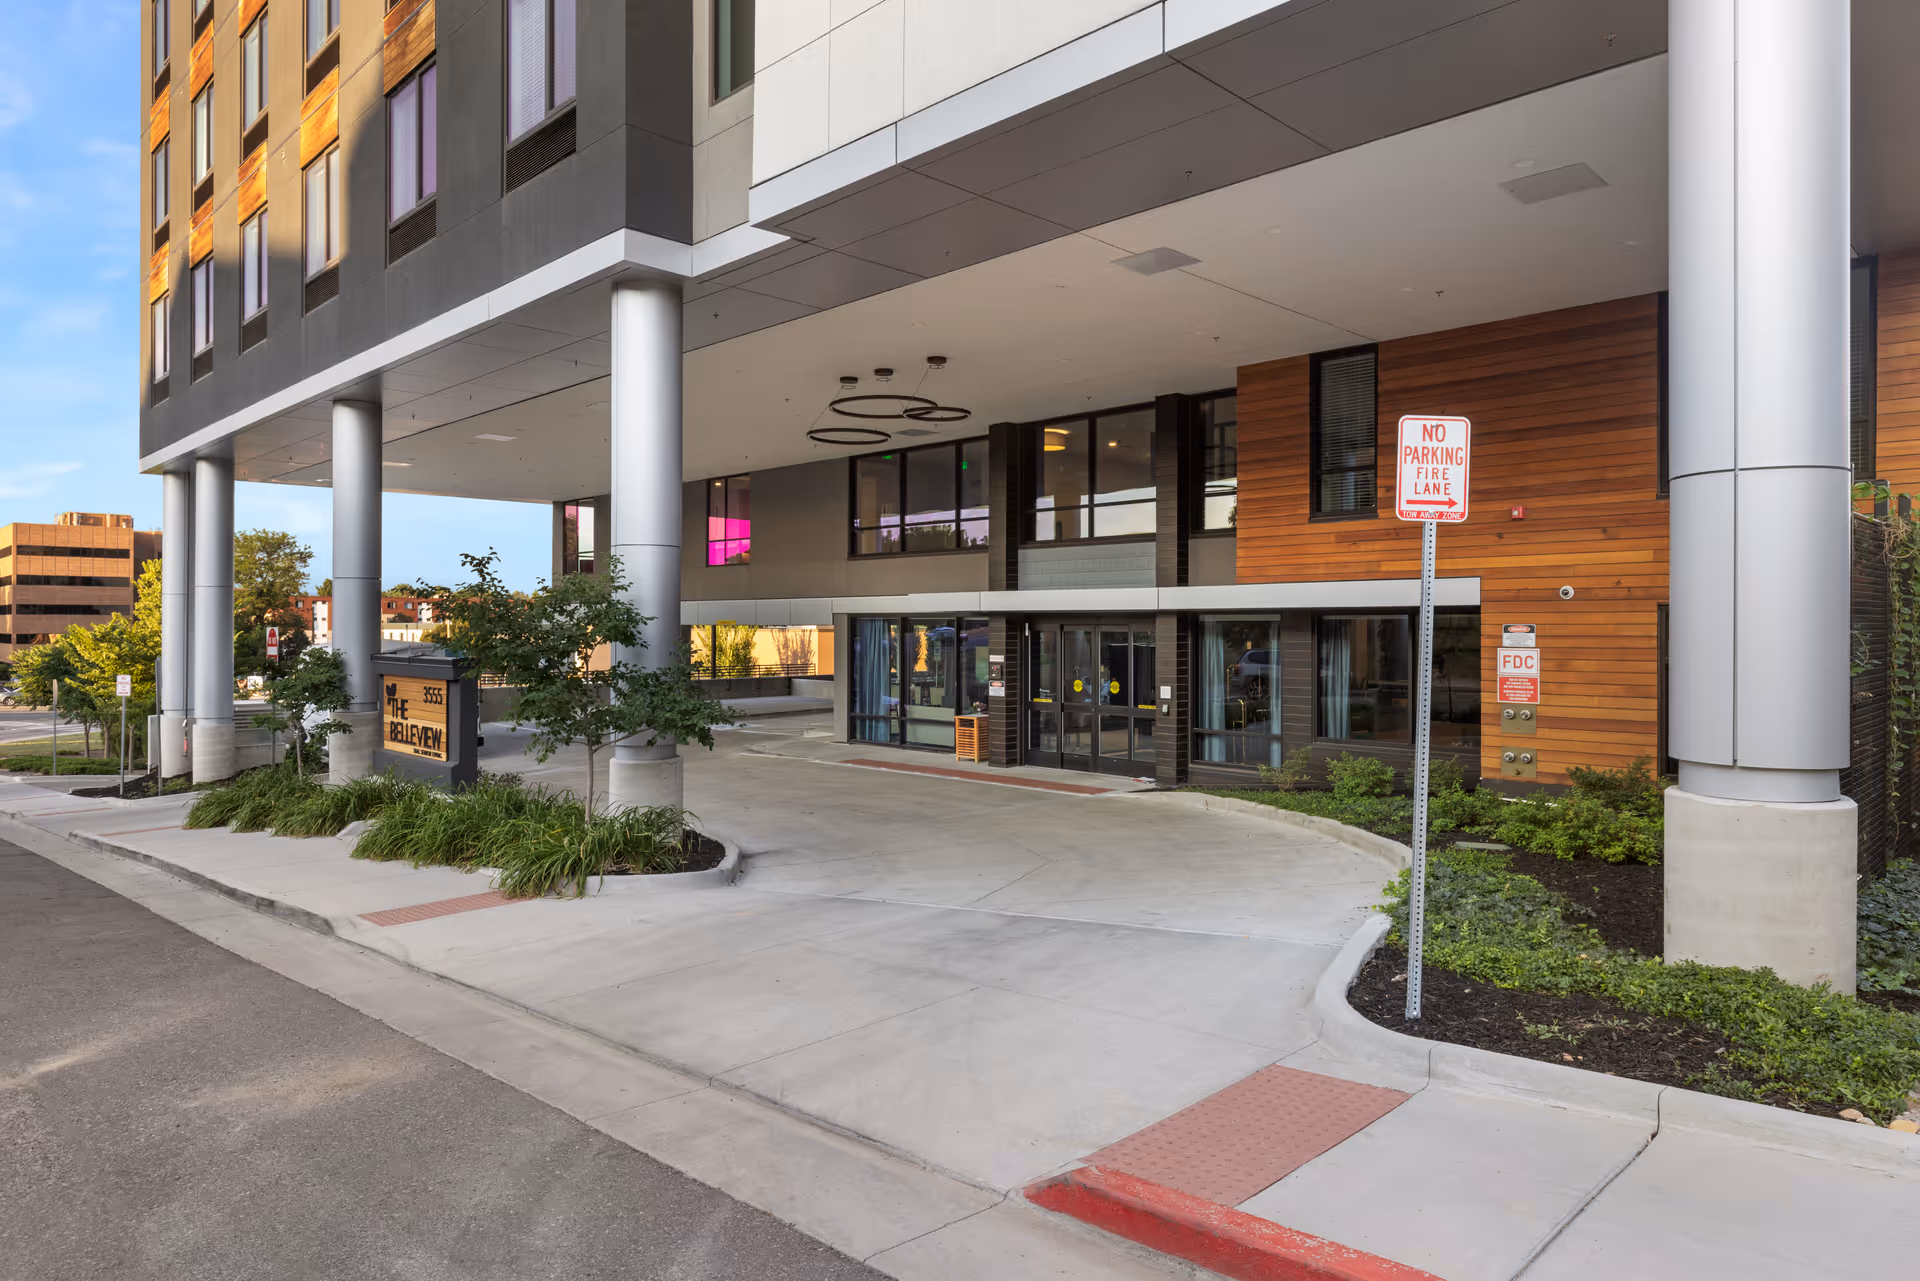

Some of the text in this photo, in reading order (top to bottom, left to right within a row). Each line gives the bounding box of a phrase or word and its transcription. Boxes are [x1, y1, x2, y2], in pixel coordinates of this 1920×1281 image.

[1422, 424, 1446, 443] NO
[1404, 446, 1463, 466] PARKING
[1417, 467, 1450, 480] FIRE
[1414, 482, 1451, 495] LANE
[1402, 510, 1462, 520] TOW AWAY ZONE
[1503, 654, 1534, 670] FDC
[423, 686, 443, 704] 3555
[387, 698, 409, 720] THE
[390, 720, 442, 750] BELLEVIEW
